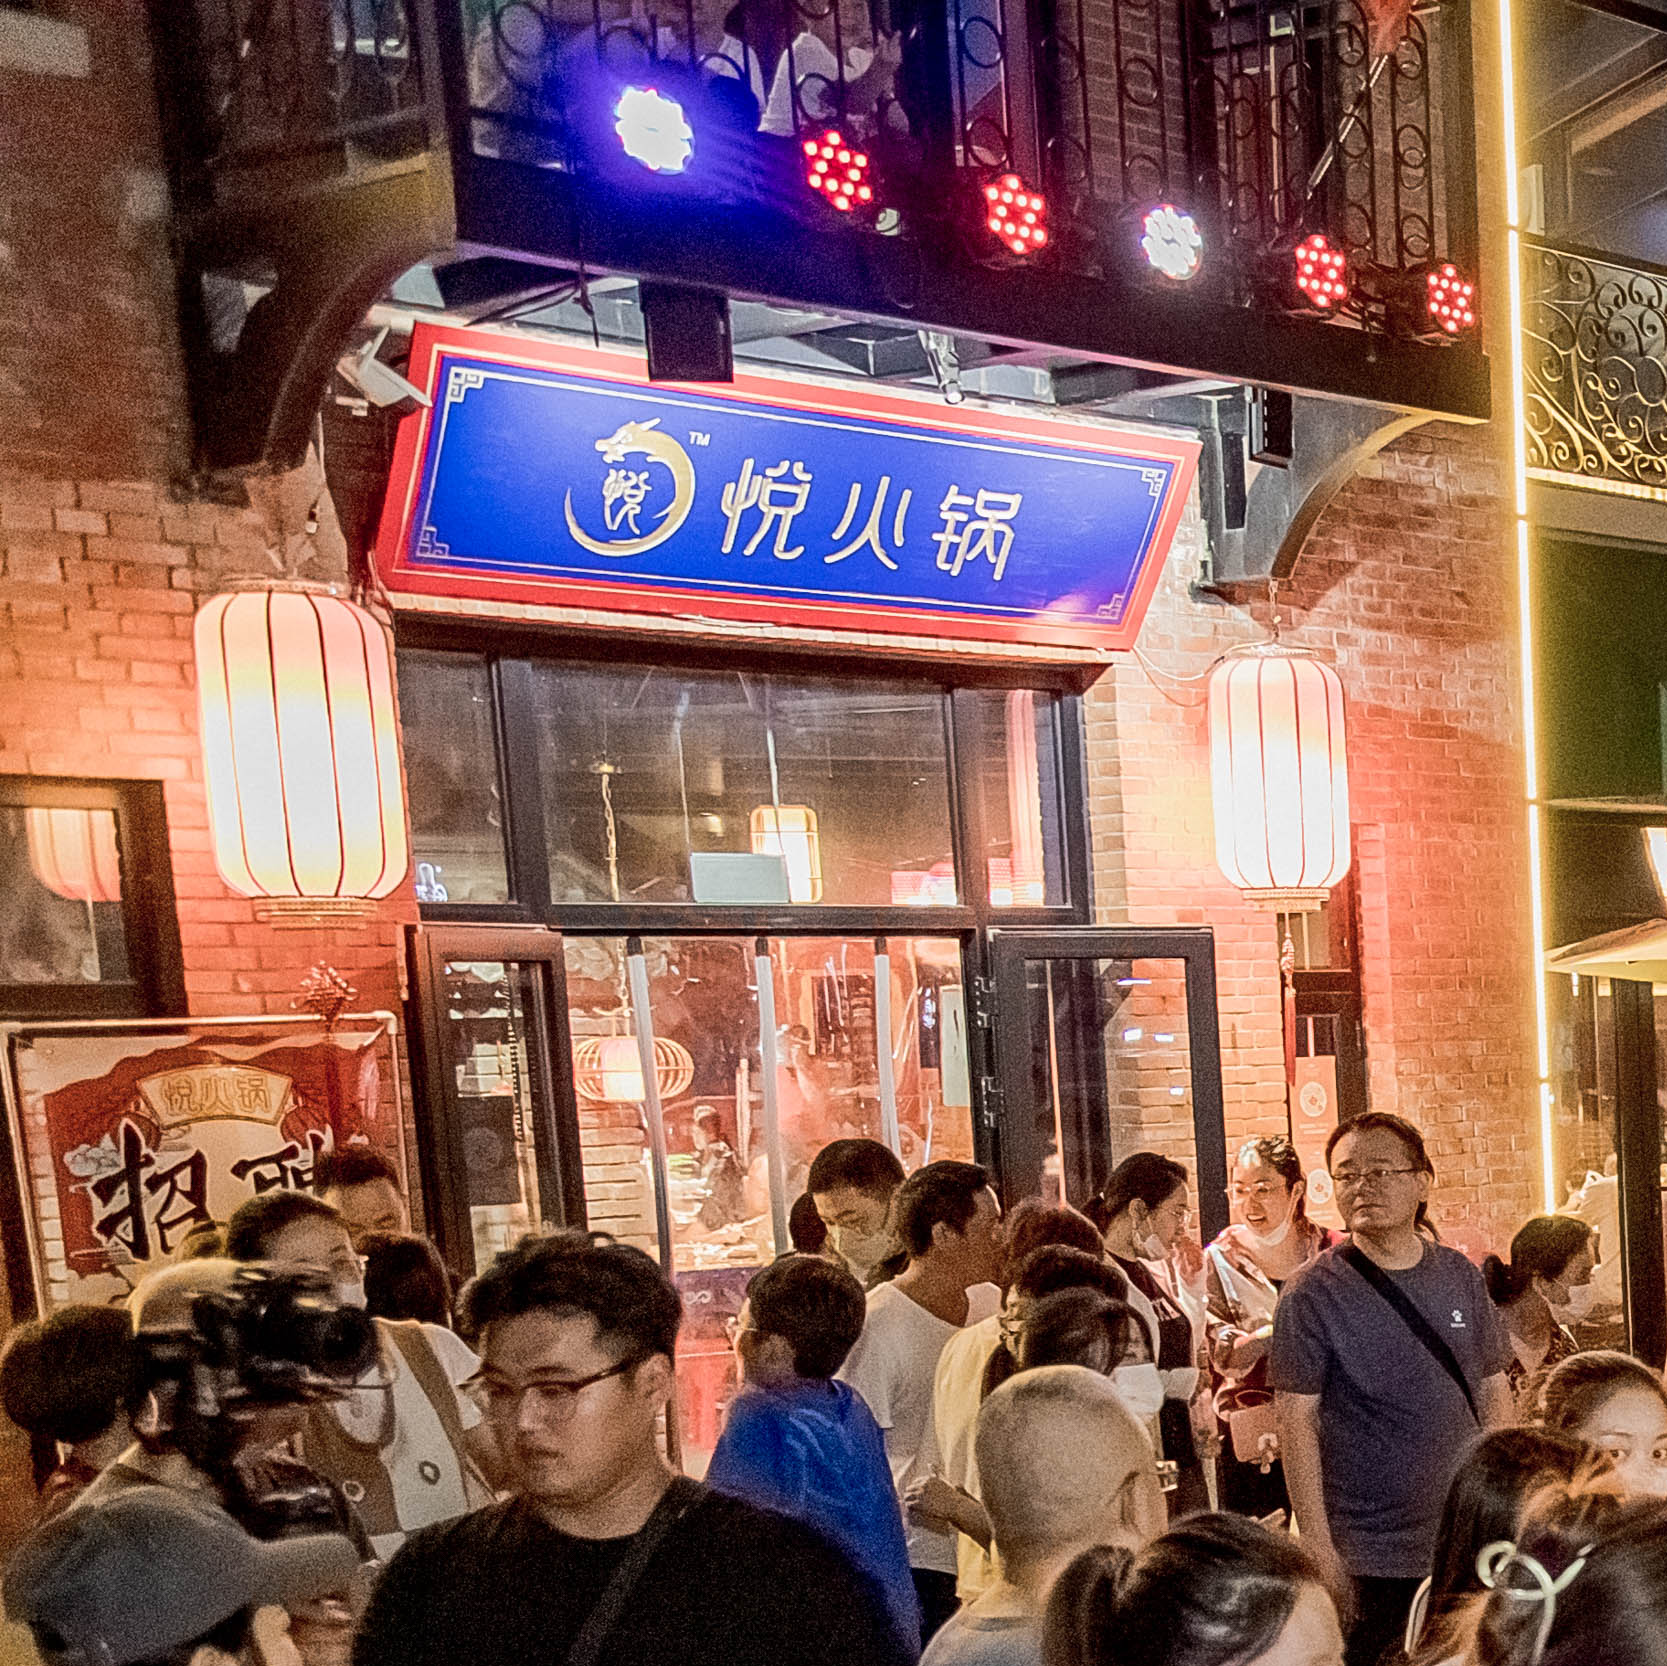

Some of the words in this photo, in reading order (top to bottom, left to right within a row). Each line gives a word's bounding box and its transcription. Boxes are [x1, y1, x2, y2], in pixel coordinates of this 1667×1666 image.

[688, 431, 711, 447] TM
[162, 1073, 273, 1116] 悦火锅
